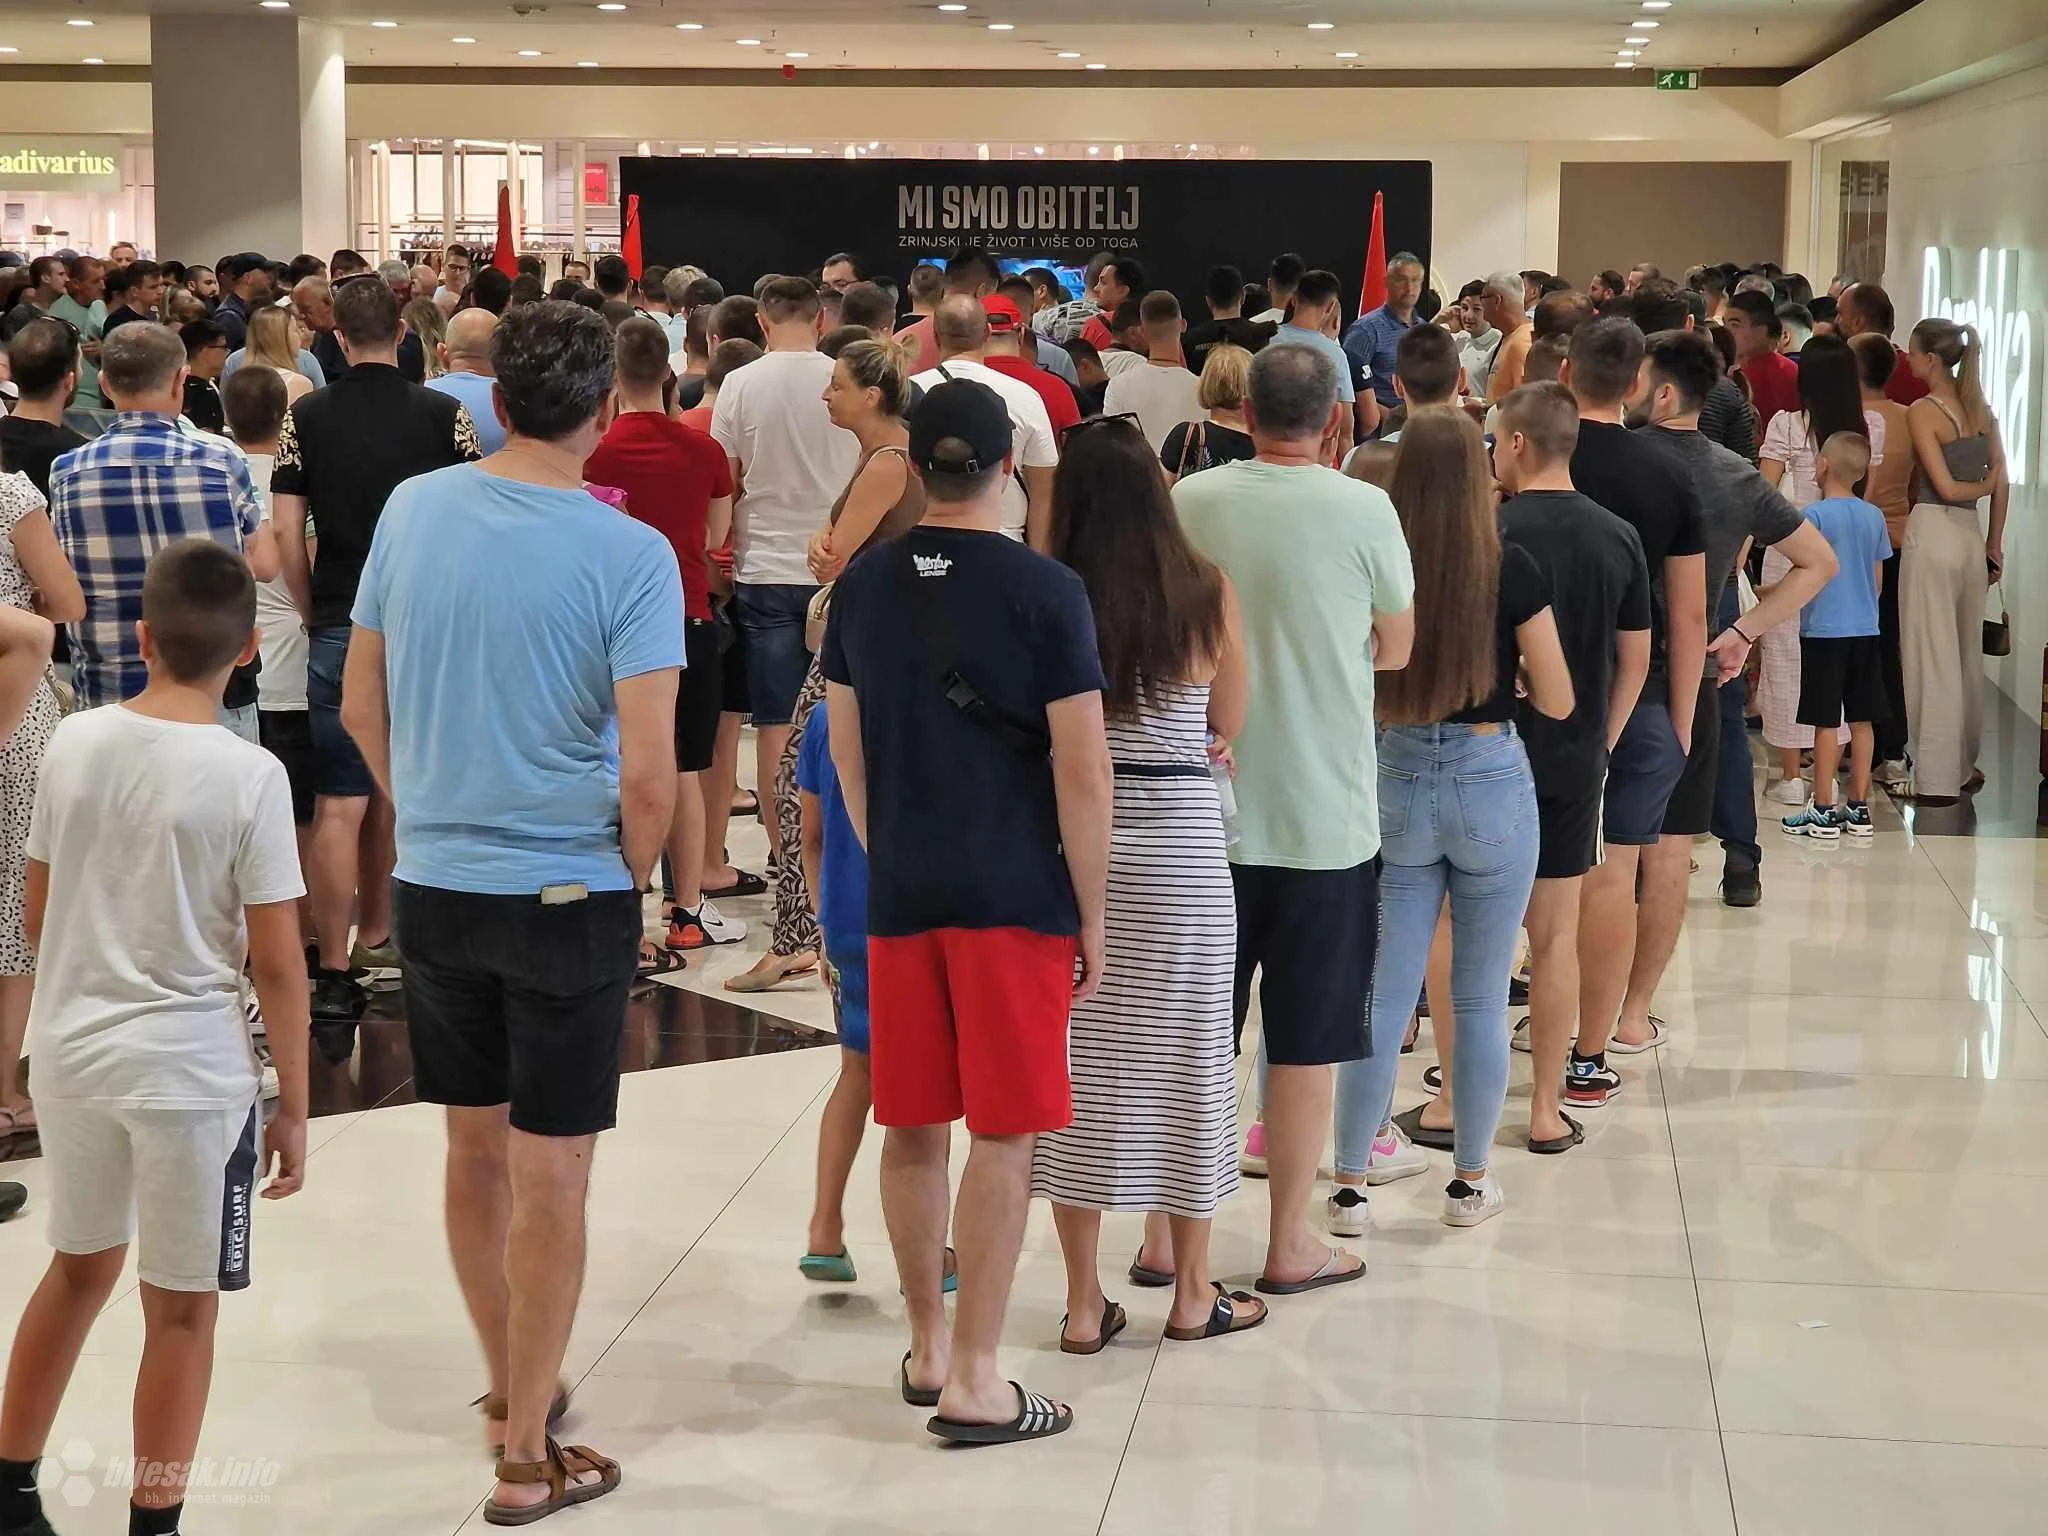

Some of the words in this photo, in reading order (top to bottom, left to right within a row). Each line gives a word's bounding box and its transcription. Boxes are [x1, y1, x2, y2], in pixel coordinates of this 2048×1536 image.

[0, 149, 115, 175] adivarius
[898, 185, 934, 229] MI
[942, 185, 1009, 230] SMO
[1017, 185, 1140, 231] OBITELJ
[899, 236, 960, 247] ZRINJSKI
[965, 236, 981, 247] JE
[986, 233, 1026, 247] ŽIVOT
[1039, 233, 1070, 247] VIŠE
[1075, 236, 1096, 248] OD
[1102, 236, 1139, 248] TOGA
[232, 1184, 244, 1227] SURF
[231, 1232, 245, 1271] EPIC
